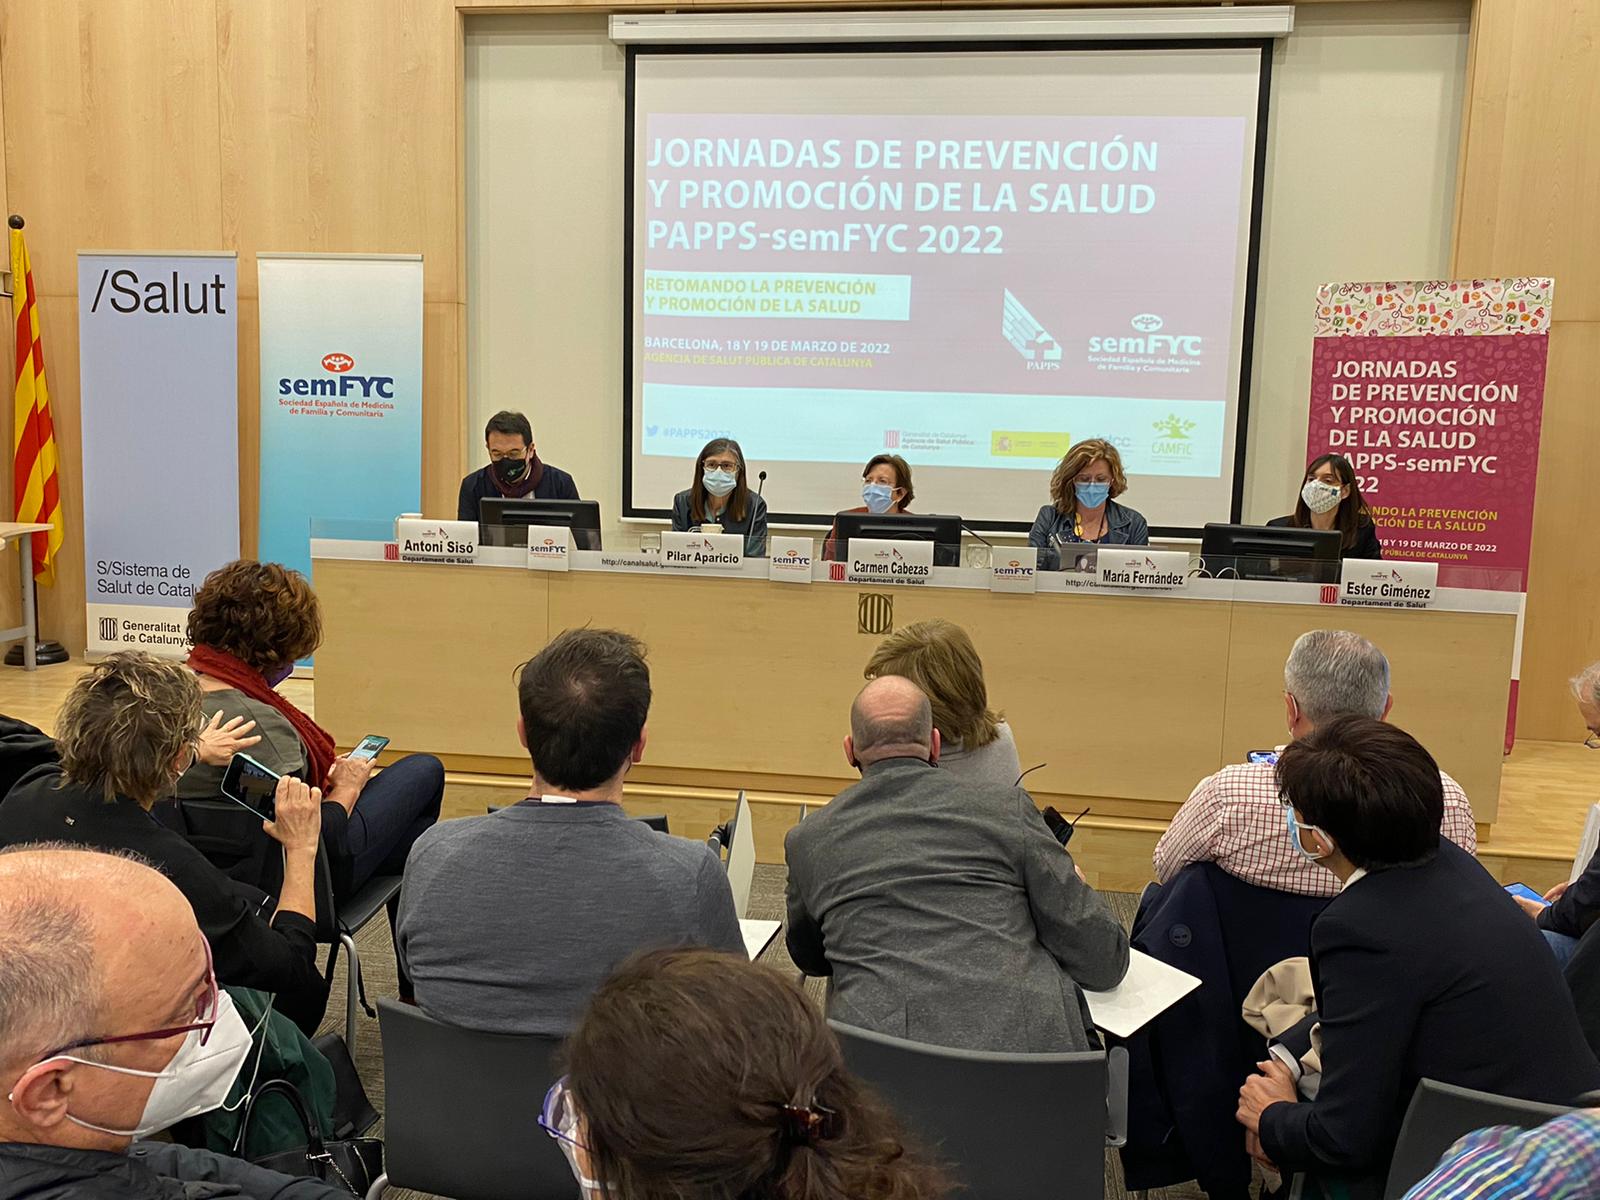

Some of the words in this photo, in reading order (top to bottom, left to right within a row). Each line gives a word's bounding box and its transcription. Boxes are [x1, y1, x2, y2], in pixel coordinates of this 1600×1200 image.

[647, 138, 841, 169] JORNADAS
[854, 140, 902, 170] DE
[915, 135, 1158, 171] PREVENCIÓN
[647, 179, 673, 208] Y
[680, 176, 904, 211] PROMOCIÓN
[914, 183, 965, 212] DE
[972, 183, 1018, 213] LA
[1027, 183, 1156, 214] SALUD
[647, 221, 908, 254] PAPPS-semFYC
[917, 225, 1004, 254] 2022
[646, 278, 746, 292] RETOMANDO
[751, 280, 770, 293] LA
[774, 279, 876, 294] PREVENCIÓN
[646, 296, 654, 308] Y
[659, 296, 755, 312] PROMOCIÓN
[760, 299, 780, 312] DE
[784, 300, 803, 312] LA
[808, 300, 860, 313] SALUD
[645, 337, 722, 351] BARCELONA,
[727, 341, 740, 351] 18
[743, 341, 751, 351] Y
[755, 341, 768, 351] 19
[771, 341, 788, 352] DE
[791, 341, 837, 352] MARZO
[840, 342, 857, 352] DE
[860, 343, 890, 354] 2022
[1089, 335, 1202, 356] semFYC
[1027, 362, 1060, 371] PAPPS
[1332, 361, 1457, 378] JORNADAS
[279, 376, 394, 398] semFYC
[1332, 384, 1361, 401] DE
[1367, 381, 1518, 402] PREVENCIÓN
[279, 399, 313, 407] Sociedad
[315, 400, 348, 409] Española
[301, 408, 328, 416] Familia
[336, 409, 384, 417] Comunitaria
[1331, 407, 1345, 424] Y
[1350, 405, 1496, 426] PROMOCIÓN
[1329, 430, 1358, 447] DE
[1364, 431, 1391, 447] LA
[1398, 431, 1476, 449] SALUD
[1329, 452, 1497, 474] APPS-semFYC
[1402, 508, 1416, 516] LA
[1420, 508, 1498, 520] PREVENCIÓN
[1408, 520, 1424, 529] DE
[1427, 521, 1442, 529] LA
[1445, 521, 1486, 531] SALUD
[404, 540, 443, 552] Antoni
[447, 541, 474, 553] Sisó
[530, 545, 566, 554] semFYC
[1424, 541, 1458, 550] MARZO
[1475, 544, 1497, 552] 2022
[402, 555, 445, 563] Departament
[667, 551, 691, 562] Pilar
[694, 552, 739, 565] Aparicio
[773, 557, 810, 565] semFYC
[1427, 552, 1468, 560] CATALUNYA
[97, 561, 168, 578] S/Sistema
[172, 565, 190, 578] de
[854, 560, 888, 574] Carmen
[891, 562, 929, 575] Cabezas
[994, 567, 1034, 575] semFYC
[1103, 569, 1130, 584] María
[1133, 570, 1183, 586] Fernández
[97, 579, 132, 594] Salut
[136, 581, 154, 595] de
[158, 582, 196, 597] Catal
[1347, 581, 1377, 596] Ester
[1381, 584, 1431, 599] Giménez
[1341, 599, 1392, 607] Departament
[122, 620, 180, 633] Generalitat
[123, 633, 135, 642] de
[139, 634, 192, 647] Catalunya
